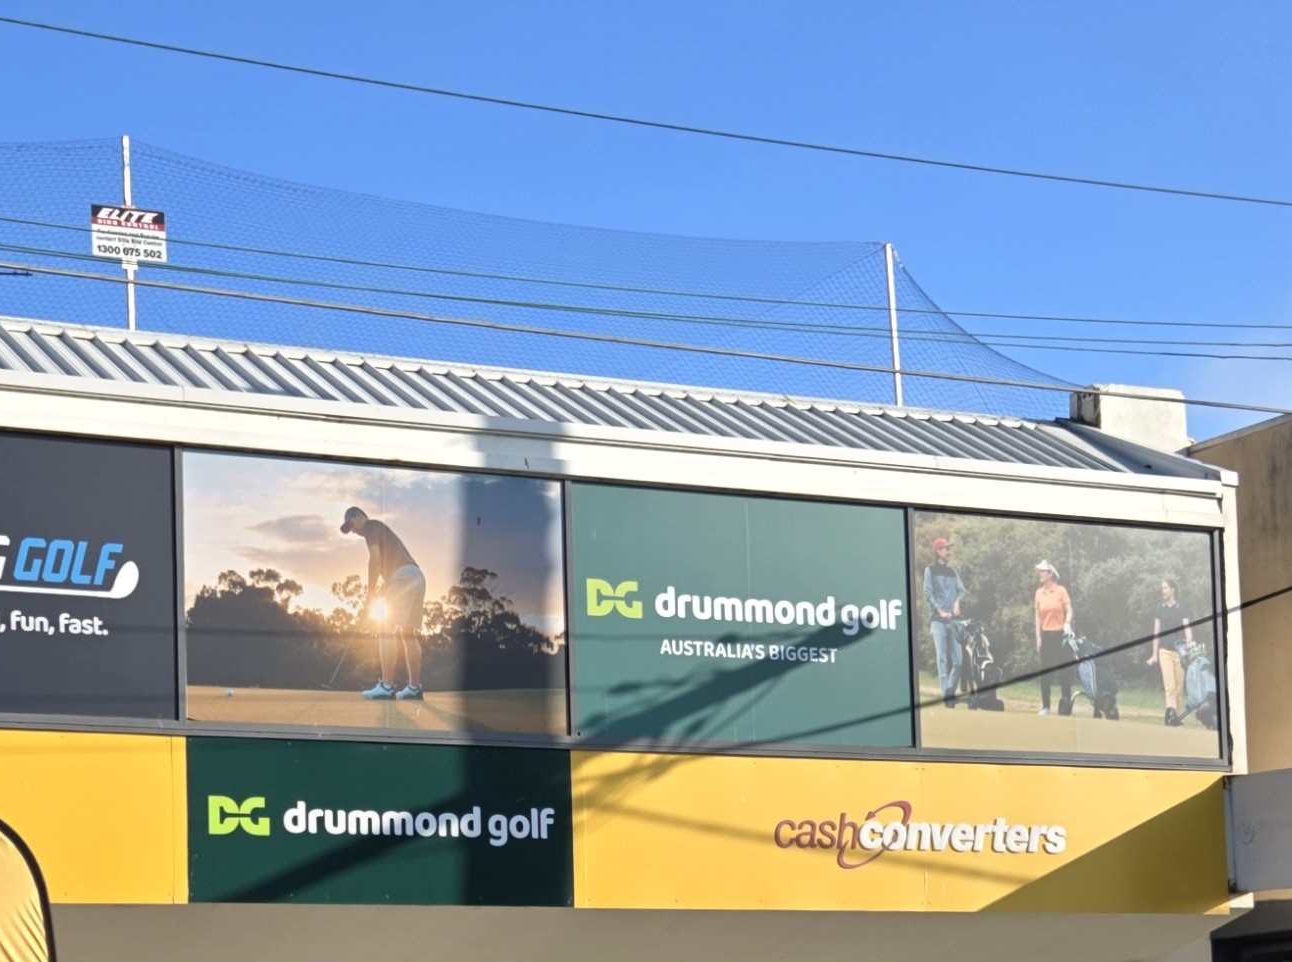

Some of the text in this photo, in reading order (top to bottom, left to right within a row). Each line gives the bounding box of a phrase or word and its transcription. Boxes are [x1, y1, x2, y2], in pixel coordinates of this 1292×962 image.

[97, 207, 159, 224] ELITE
[121, 220, 159, 230] CONTROL
[97, 244, 162, 259] 1300 675 502
[13, 537, 124, 586] GOLF
[10, 610, 55, 636] fun,
[59, 612, 109, 636] fast.
[654, 586, 836, 627] drummond
[840, 598, 903, 636] golf
[660, 638, 838, 664] AUSTRALIA'S BIGGEST
[283, 800, 481, 838] drummond
[488, 806, 556, 847] golf
